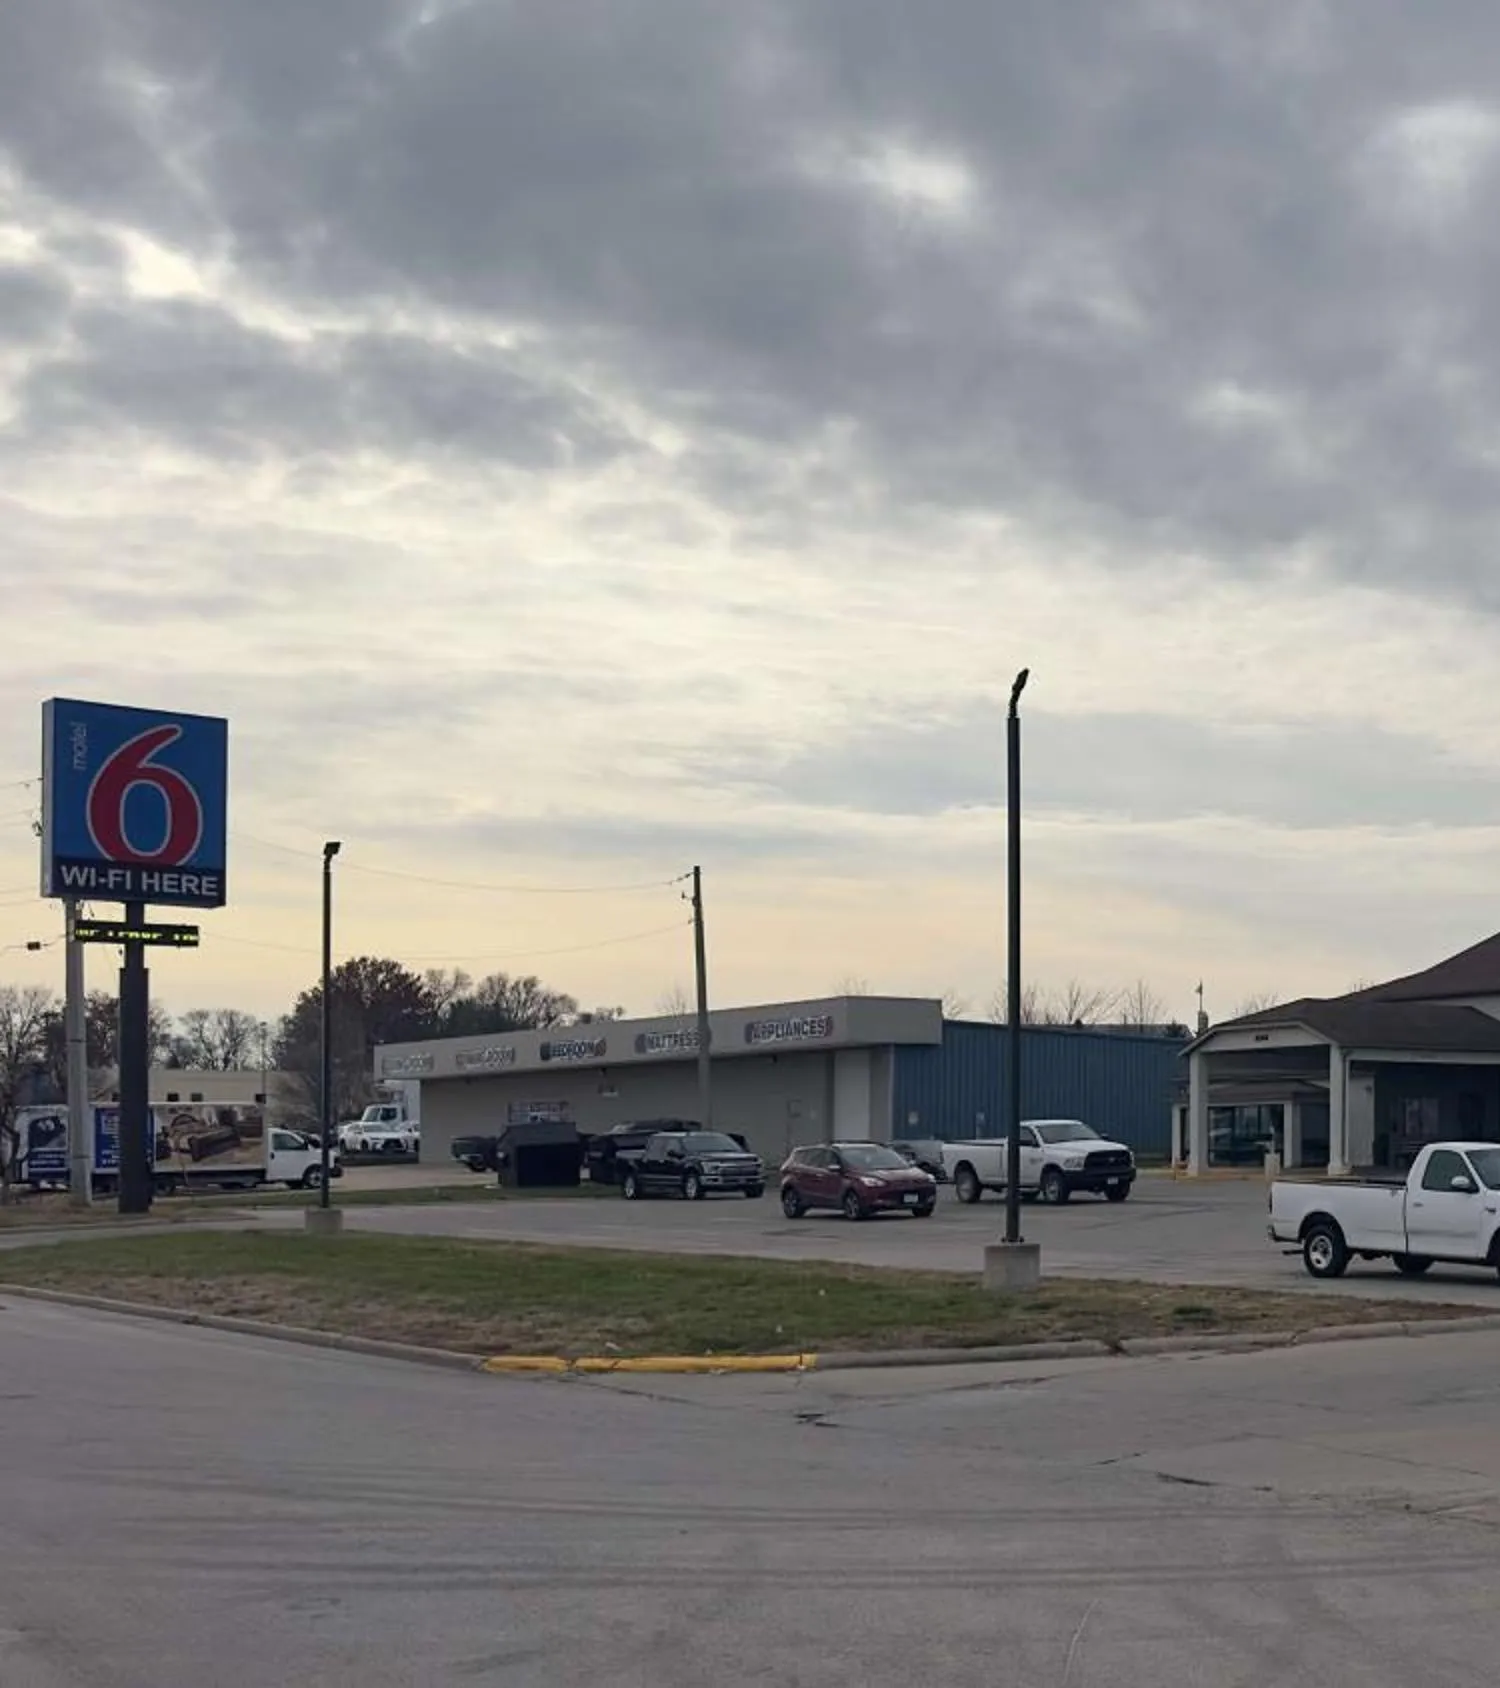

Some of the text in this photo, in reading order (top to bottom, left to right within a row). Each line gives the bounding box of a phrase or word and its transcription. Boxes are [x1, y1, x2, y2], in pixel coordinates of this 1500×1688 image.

[69, 721, 88, 771] motel
[86, 723, 203, 867] 6
[60, 865, 219, 896] WI-FI HERE
[753, 1017, 826, 1041] APPLIANCES
